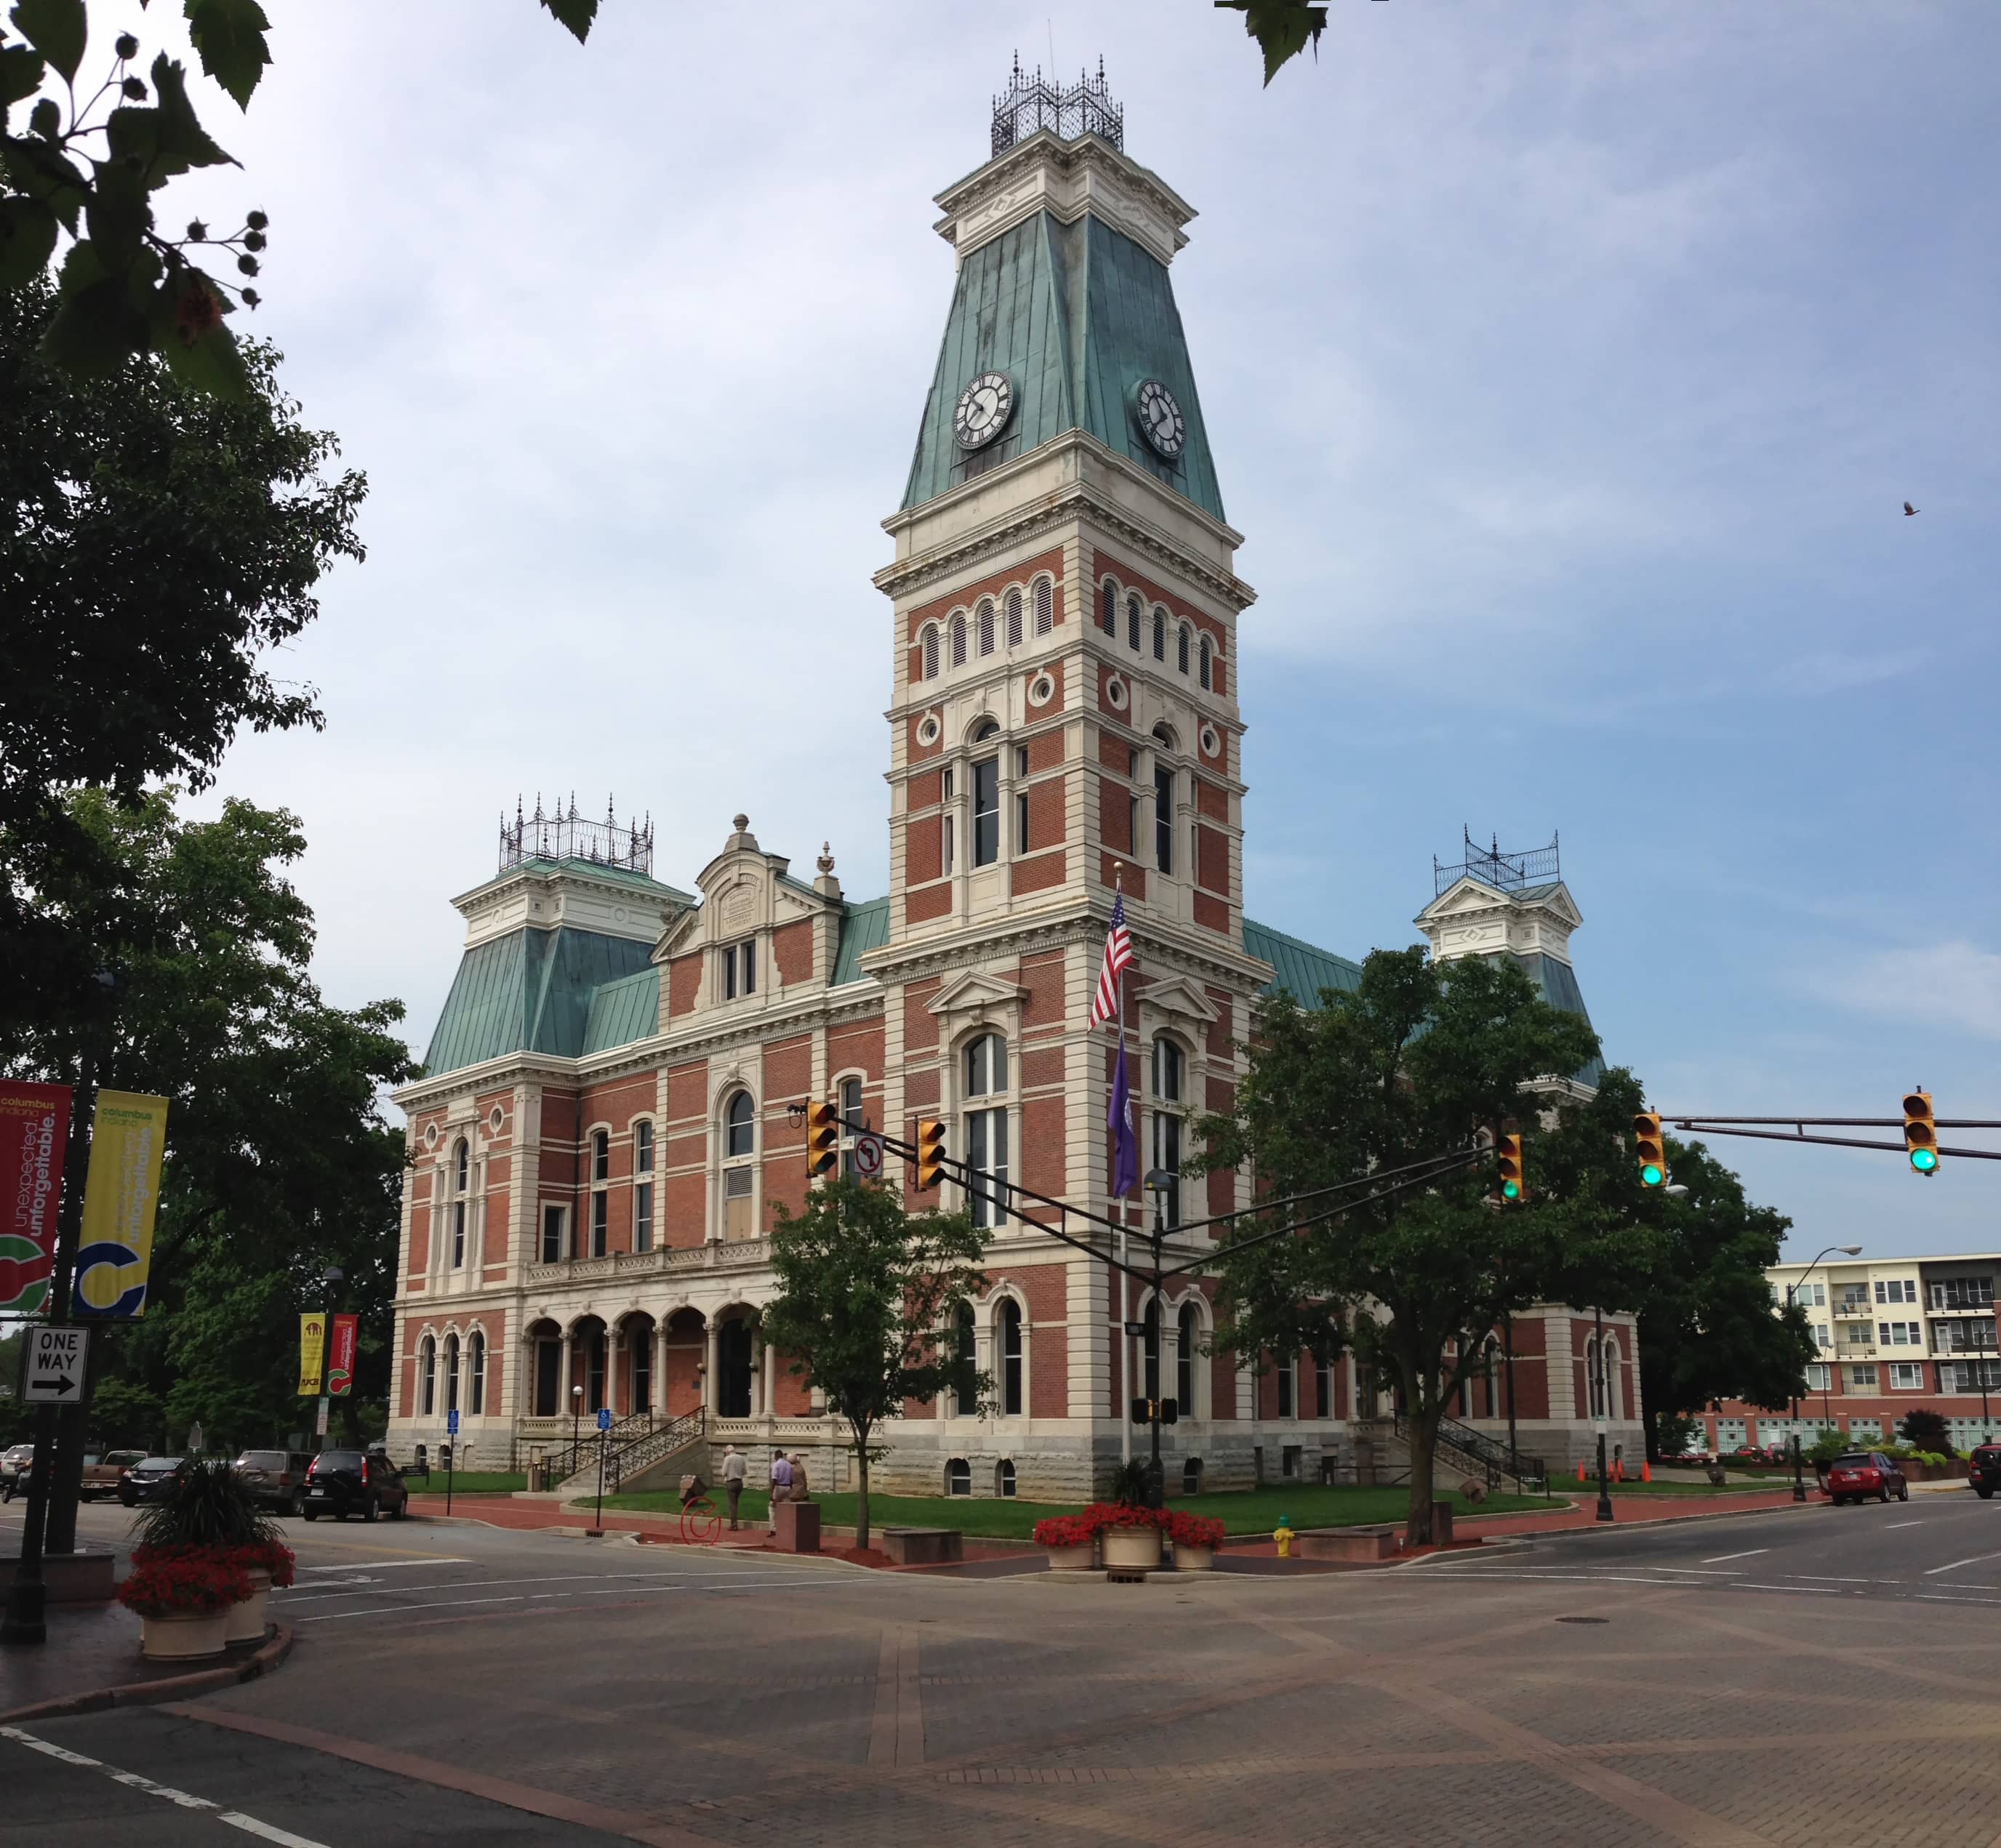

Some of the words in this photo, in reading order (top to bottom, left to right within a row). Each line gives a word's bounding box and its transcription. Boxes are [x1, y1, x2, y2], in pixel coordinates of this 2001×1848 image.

[1, 1097, 55, 1109] columbus
[102, 1107, 152, 1120] columbus
[15, 1120, 39, 1226] unexpected.
[30, 1112, 55, 1236] unforgettable.
[41, 1333, 78, 1350] ONE
[38, 1353, 77, 1370] WAY
